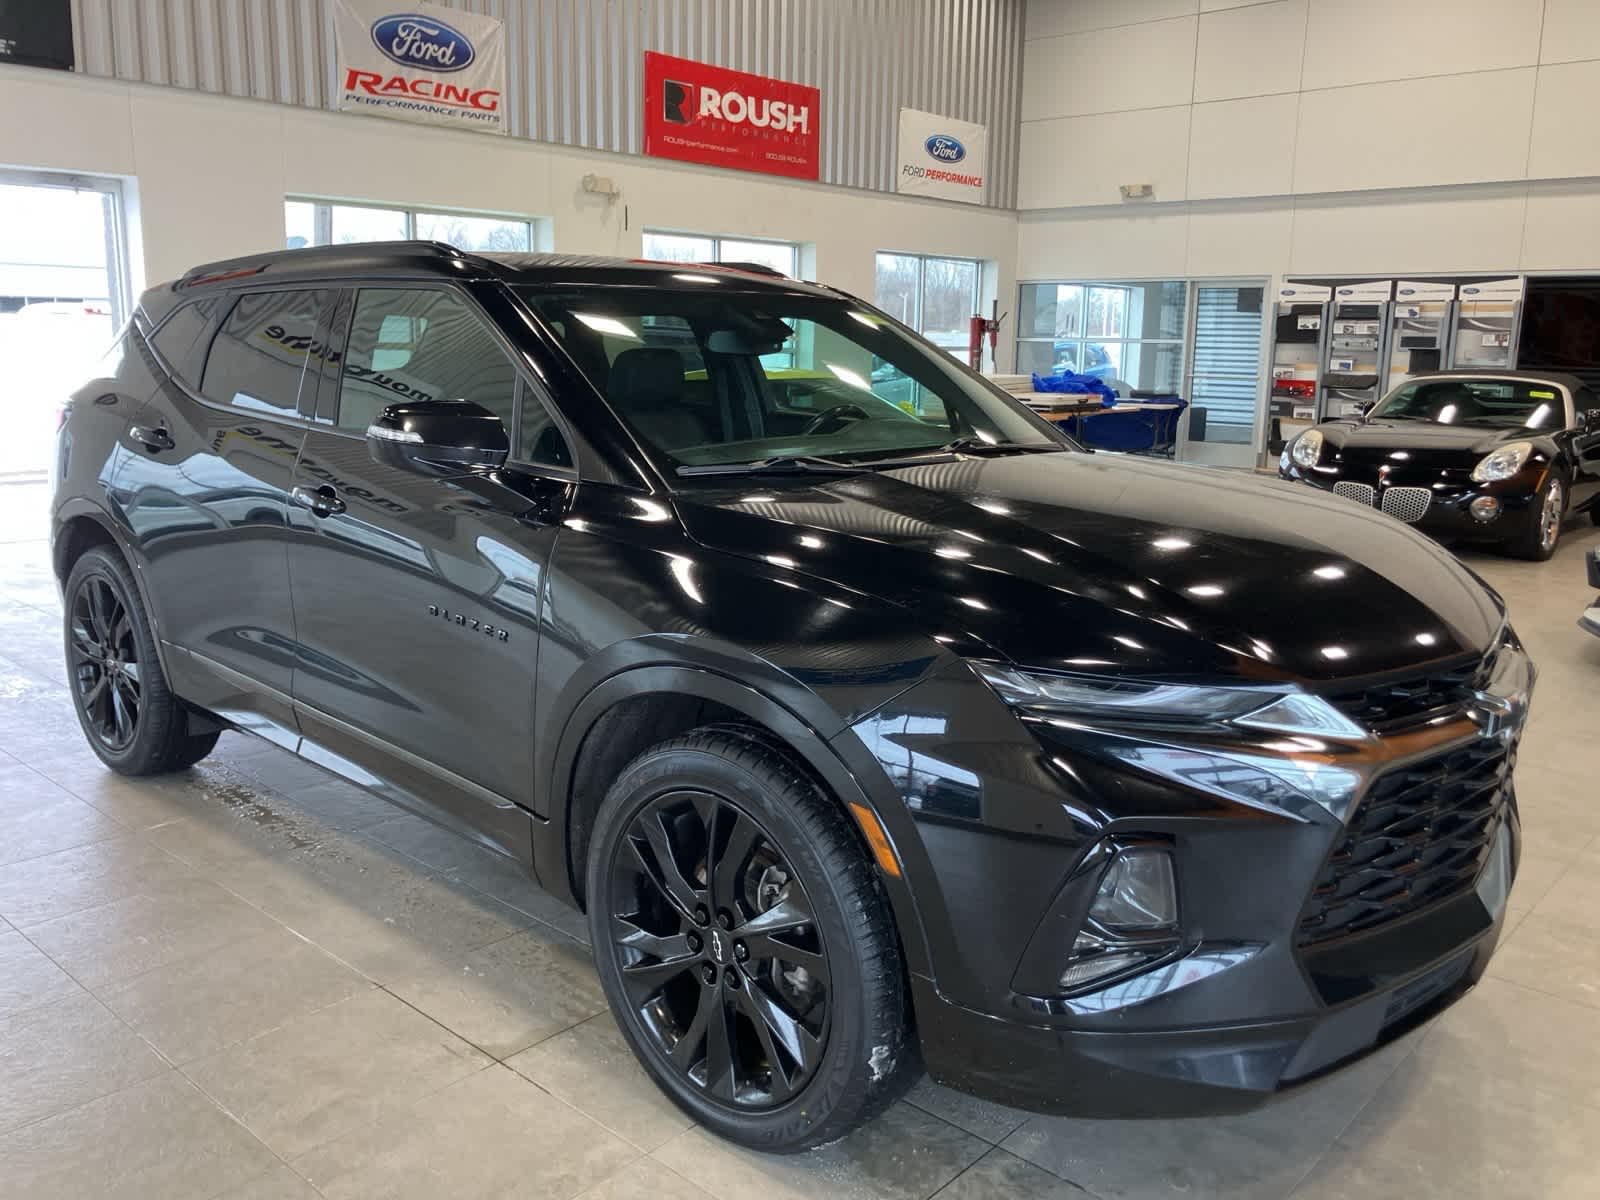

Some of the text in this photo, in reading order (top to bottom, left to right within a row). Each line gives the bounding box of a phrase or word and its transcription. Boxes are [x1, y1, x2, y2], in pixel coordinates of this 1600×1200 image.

[393, 22, 456, 66] Ford
[345, 94, 501, 123] PERFORMANCE PARTS
[346, 68, 500, 111] RACING
[700, 87, 808, 134] ROUSH
[933, 139, 957, 160] Ford
[902, 165, 983, 187] FORD PERFORMANCE
[427, 604, 509, 643] BLAZER
